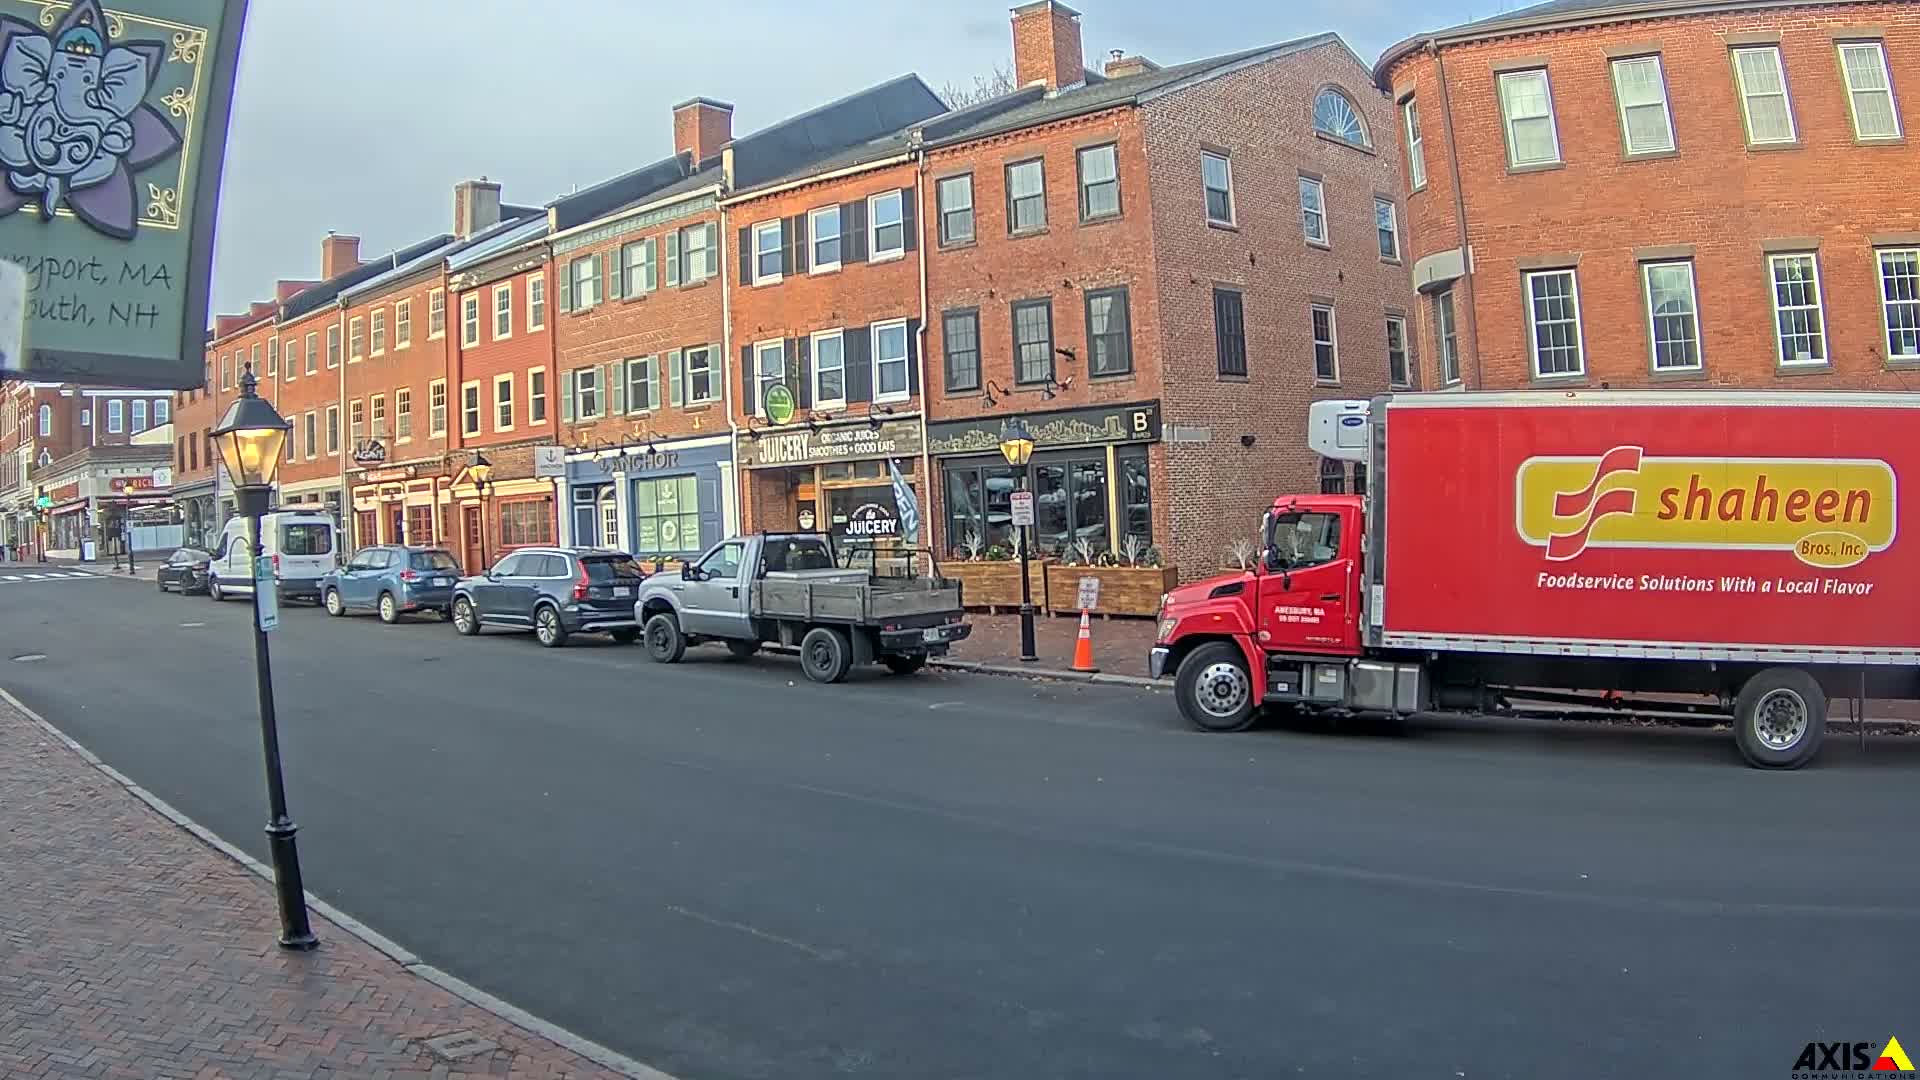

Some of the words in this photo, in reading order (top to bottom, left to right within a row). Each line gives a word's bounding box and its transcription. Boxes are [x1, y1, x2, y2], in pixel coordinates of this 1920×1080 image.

[3, 254, 107, 292] ryport,
[119, 261, 172, 289] MA
[25, 293, 96, 326] outh,
[109, 301, 159, 328] NH
[1133, 411, 1148, 431] B
[821, 431, 853, 443] ORGANIC
[854, 430, 879, 440] JUICES
[758, 433, 809, 464] JUICERY
[808, 445, 848, 457] SMOOTHIES
[854, 442, 876, 454] GOOD
[878, 440, 896, 452] EATS
[613, 453, 680, 472] ANCHOR
[893, 481, 918, 530] PEN
[1657, 474, 1871, 523] shaheen
[845, 519, 897, 535] JUICERY
[1801, 540, 1836, 556] Bros.,
[1840, 541, 1863, 556] Inc.
[1537, 572, 1634, 590] Foodservice
[1639, 574, 1714, 592] Solutions
[1720, 576, 1756, 593] With
[1761, 582, 1771, 593] a
[1777, 577, 1818, 594] Local
[1824, 578, 1873, 595] Flavor
